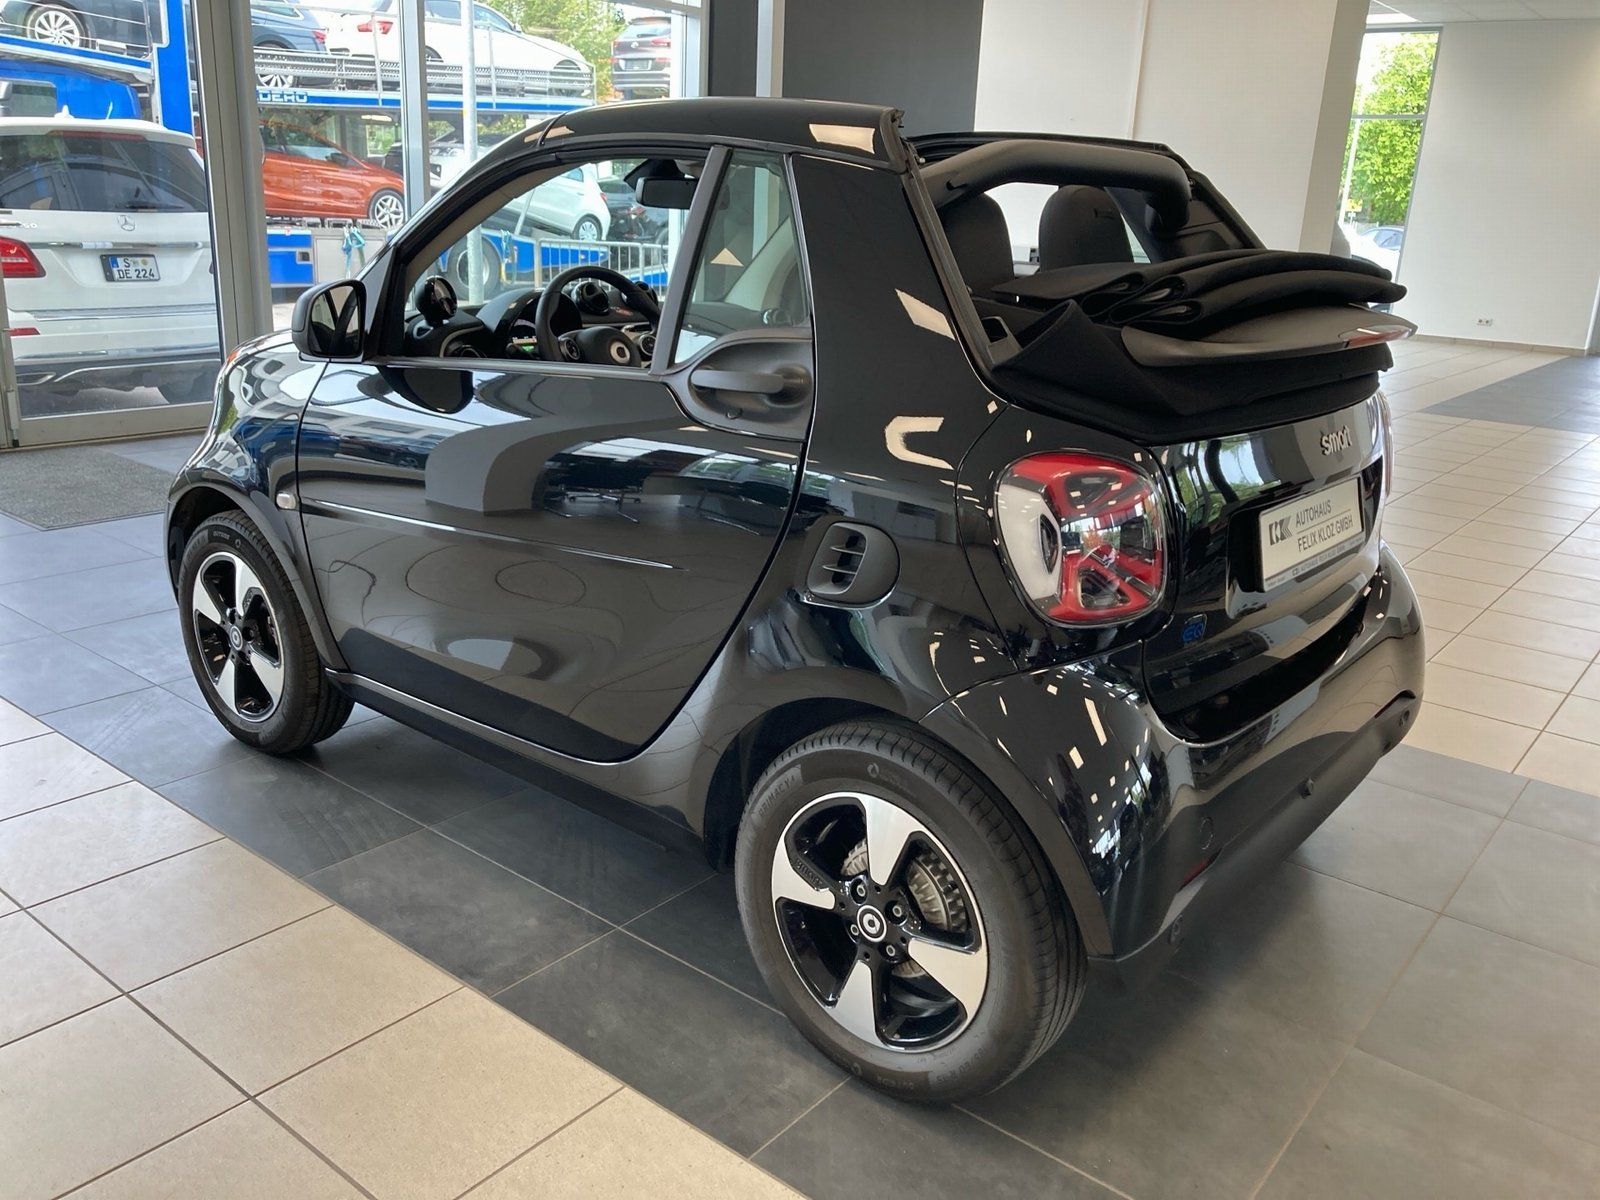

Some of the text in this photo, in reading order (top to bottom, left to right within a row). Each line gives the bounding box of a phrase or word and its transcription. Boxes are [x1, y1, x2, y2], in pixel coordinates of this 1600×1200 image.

[117, 268, 155, 279] DE 224
[123, 257, 131, 268] S
[1320, 425, 1353, 456] smart
[1295, 499, 1332, 528] AUTOHAUS
[1297, 530, 1318, 552] FELIX
[1318, 521, 1335, 543] KLOZ
